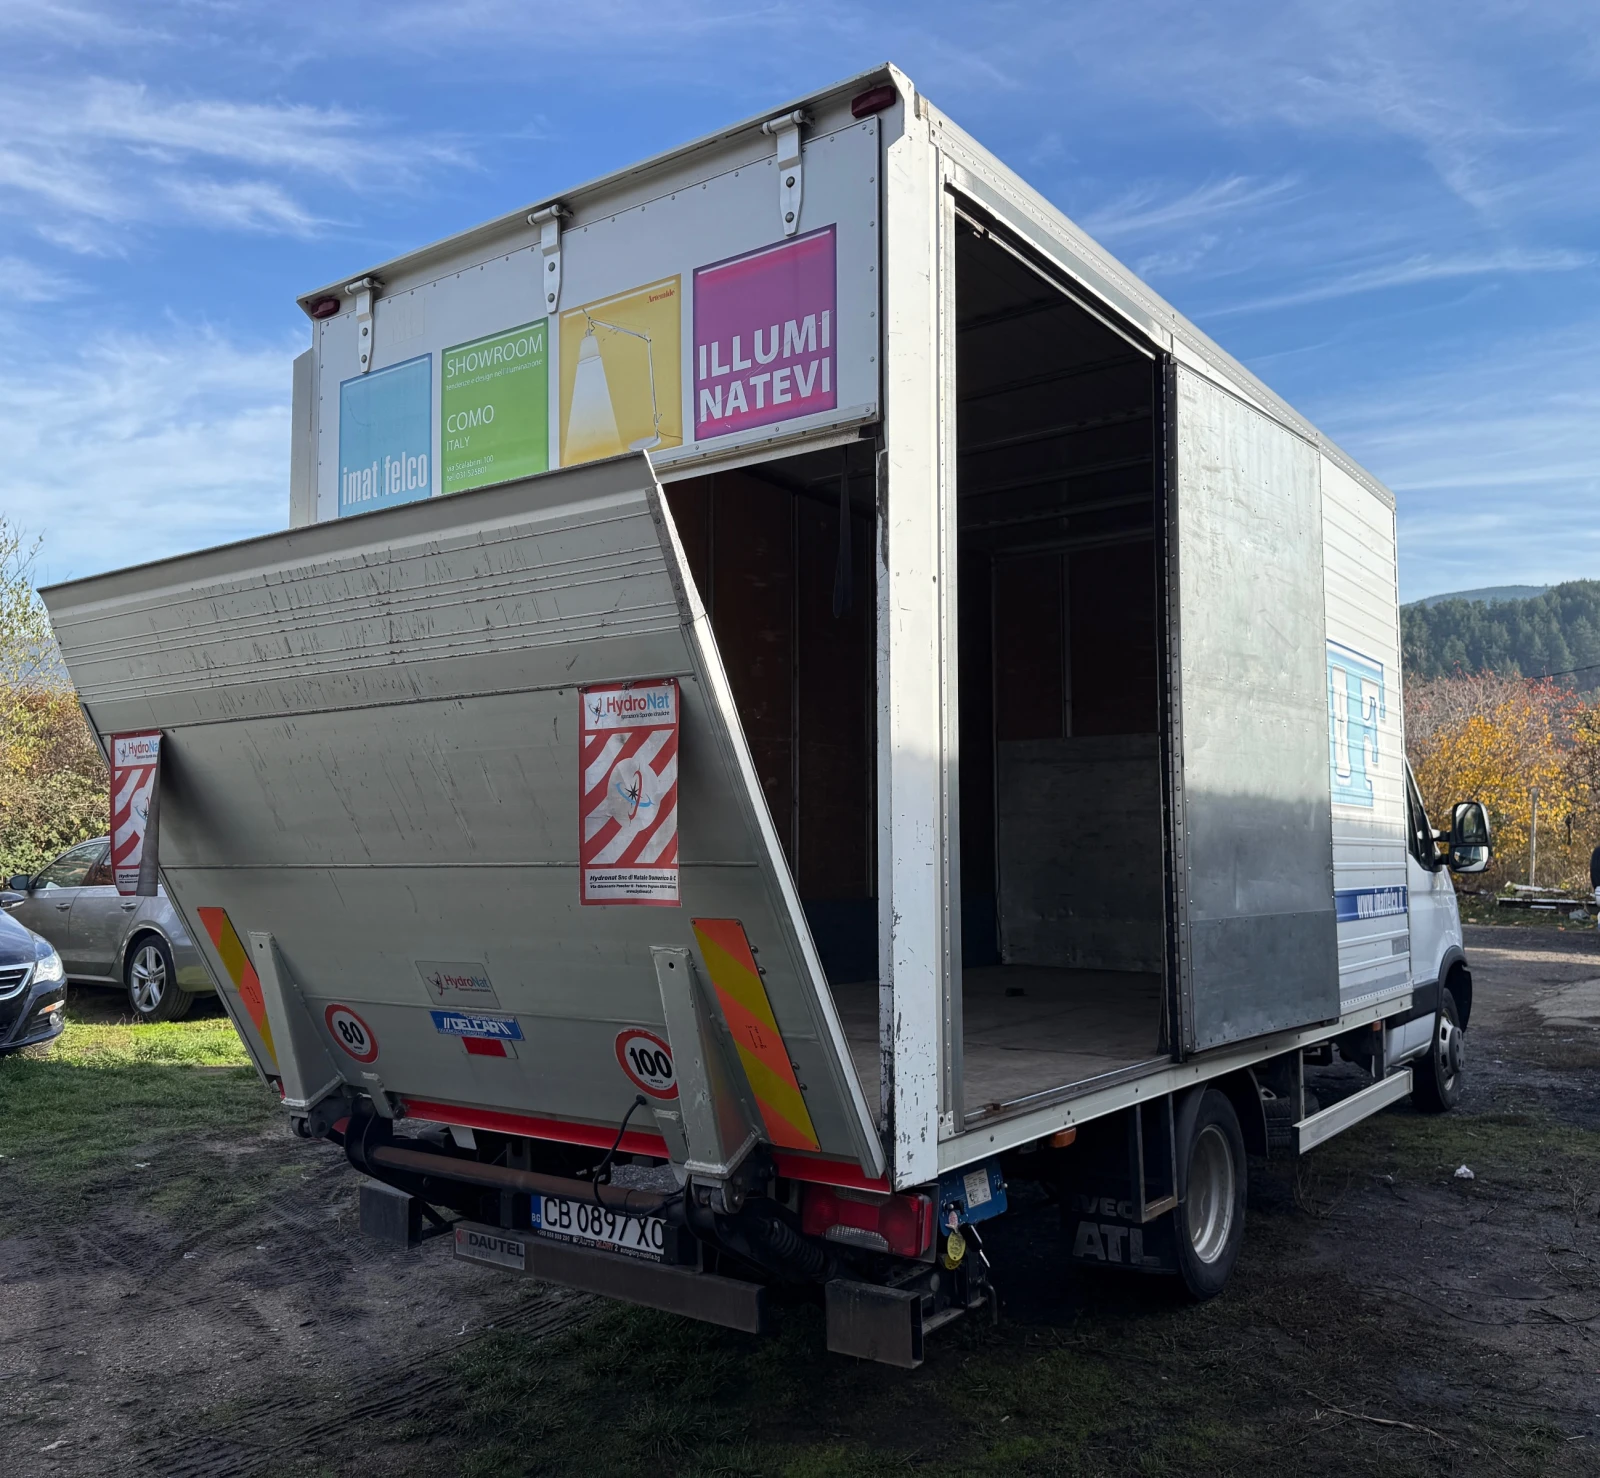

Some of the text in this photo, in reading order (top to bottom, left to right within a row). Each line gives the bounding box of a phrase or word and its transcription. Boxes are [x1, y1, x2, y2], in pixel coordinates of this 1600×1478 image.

[446, 333, 543, 378] SHOWROOM
[699, 310, 830, 380] ILLUMI
[475, 372, 493, 383] design
[700, 357, 830, 422] NATEVI
[446, 404, 495, 433] COMO
[446, 436, 470, 451] ITALY
[342, 452, 428, 505] imat felco
[606, 692, 669, 717] HydroNat
[128, 739, 158, 757] HydroNa
[444, 975, 489, 989] HydroNat
[338, 1020, 364, 1045] 80
[450, 1018, 501, 1034] DELCAR
[629, 1047, 672, 1079] 100
[1072, 1194, 1132, 1219] IVEC
[531, 1212, 541, 1223] BG
[544, 1197, 572, 1229] CB
[577, 1203, 631, 1242] 0897
[469, 1233, 524, 1257] DAUTEL
[1072, 1220, 1161, 1267] ATL
